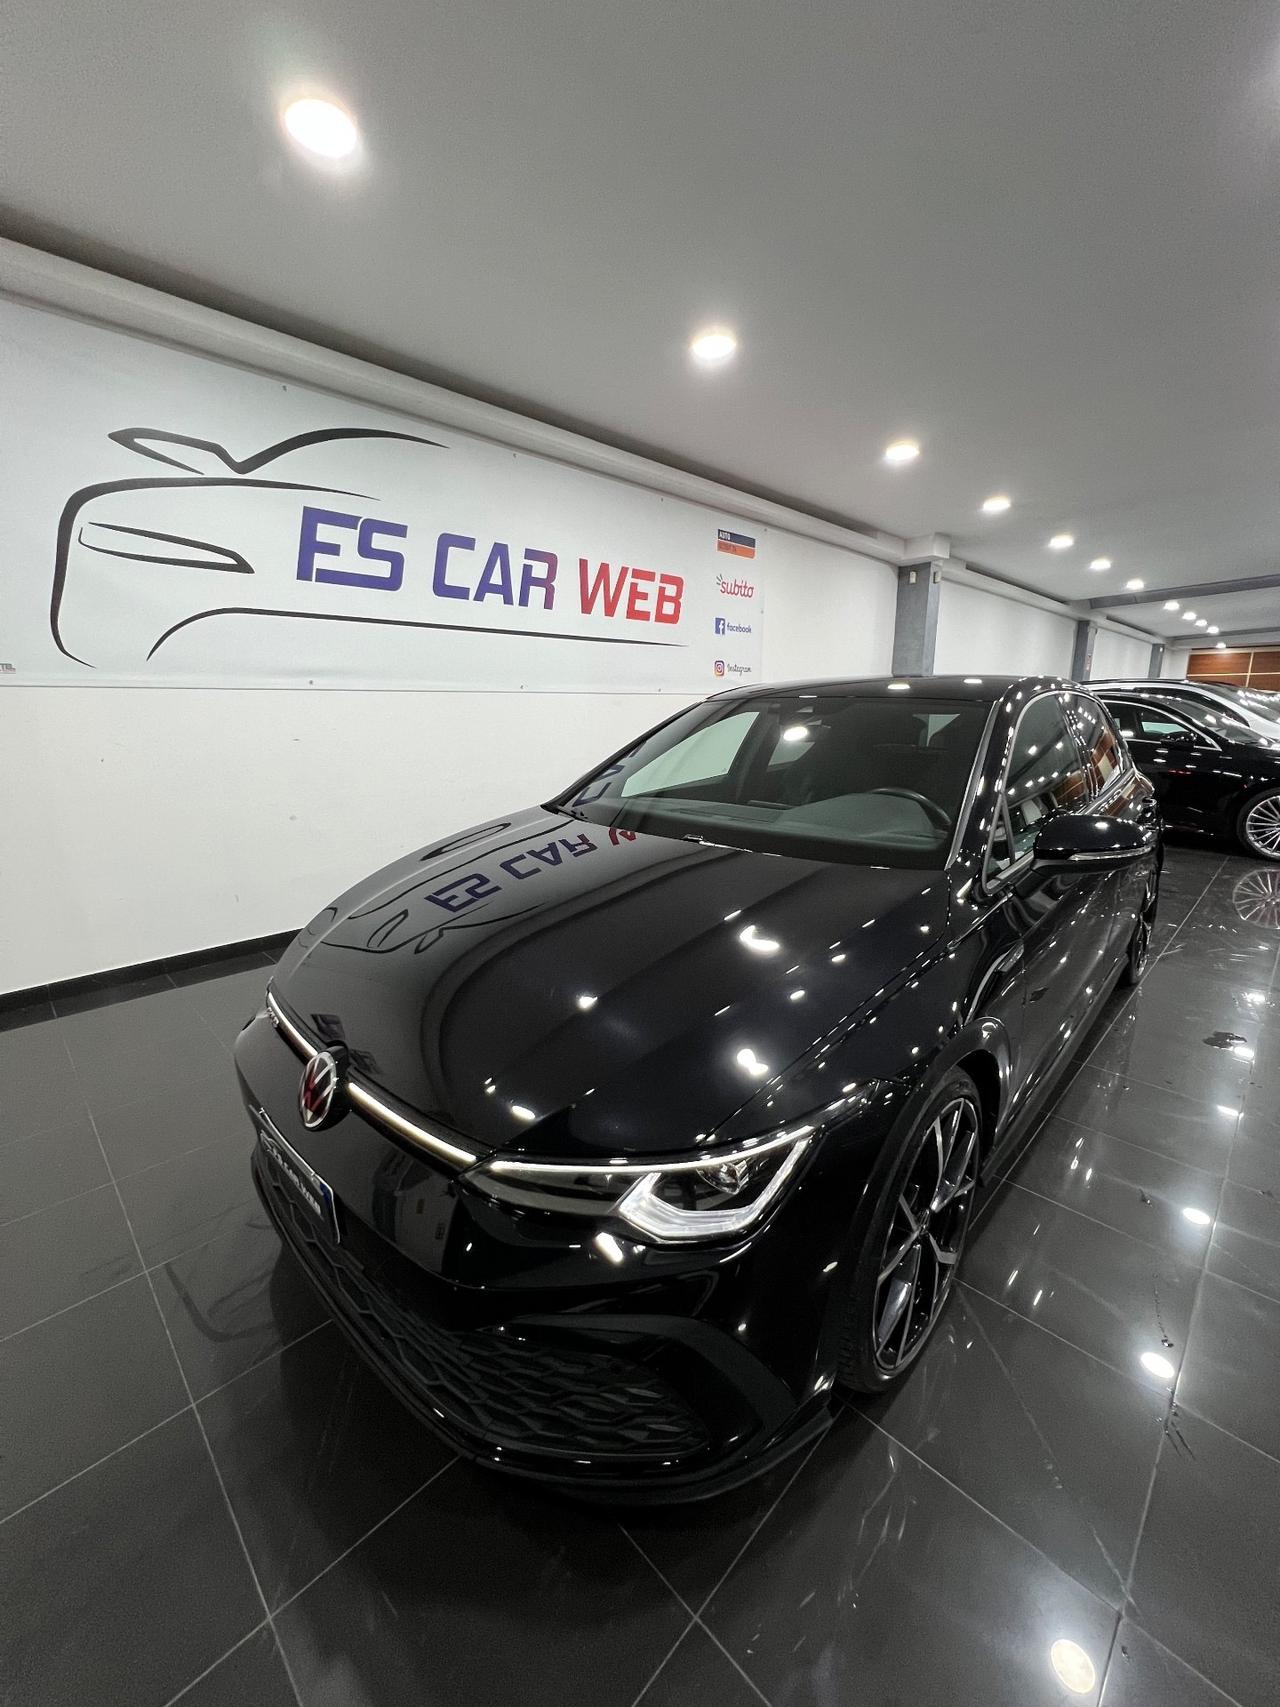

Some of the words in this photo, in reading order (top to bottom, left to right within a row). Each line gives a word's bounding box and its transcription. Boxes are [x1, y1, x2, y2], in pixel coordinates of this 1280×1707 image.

[296, 505, 409, 592] ES
[432, 532, 559, 610] CAR
[578, 557, 685, 625] WEB
[719, 578, 755, 599] subito
[726, 621, 753, 634] facebook
[726, 663, 753, 677] Instagram
